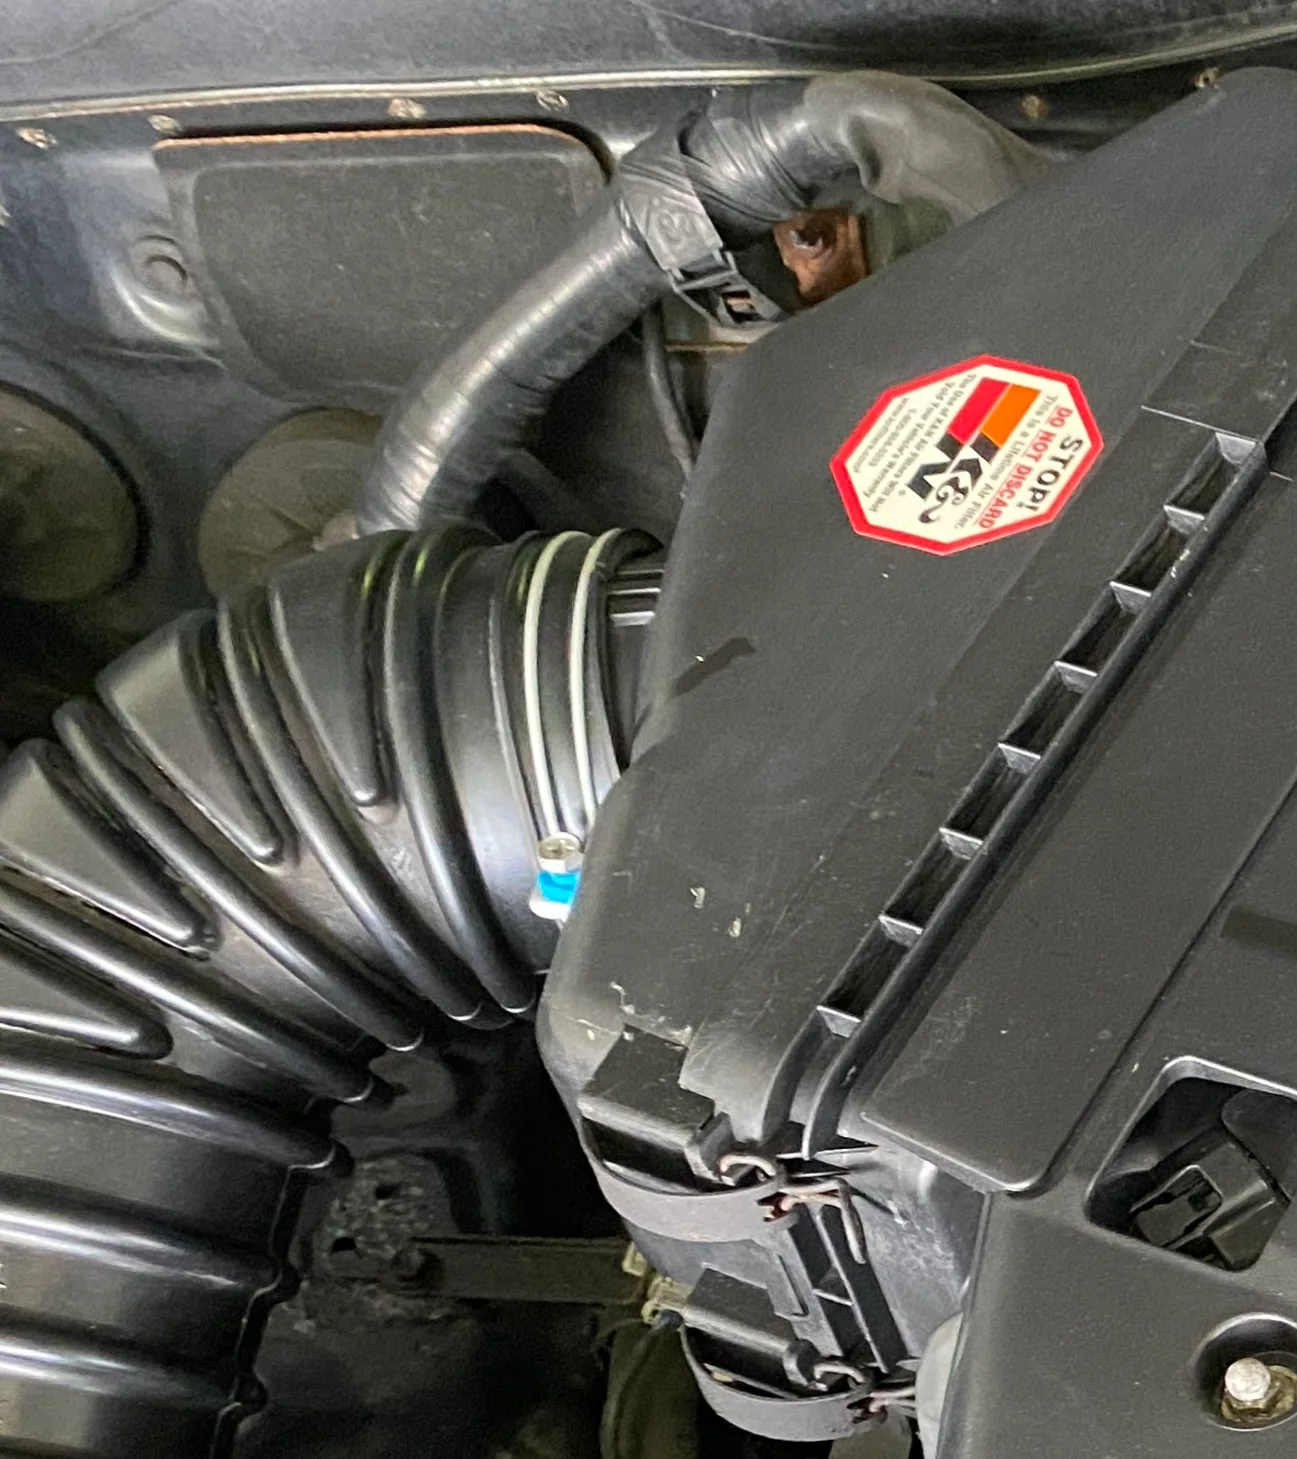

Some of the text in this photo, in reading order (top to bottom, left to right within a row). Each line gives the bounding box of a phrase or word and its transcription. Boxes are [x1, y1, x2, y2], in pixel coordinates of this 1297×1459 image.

[1035, 395, 1058, 416] This
[906, 430, 1001, 524] K&N
[978, 407, 1073, 530] DO NOT DISCARD
[990, 440, 1025, 481] Lifetime
[1015, 435, 1083, 511] STOP!
[977, 483, 994, 499] Air
